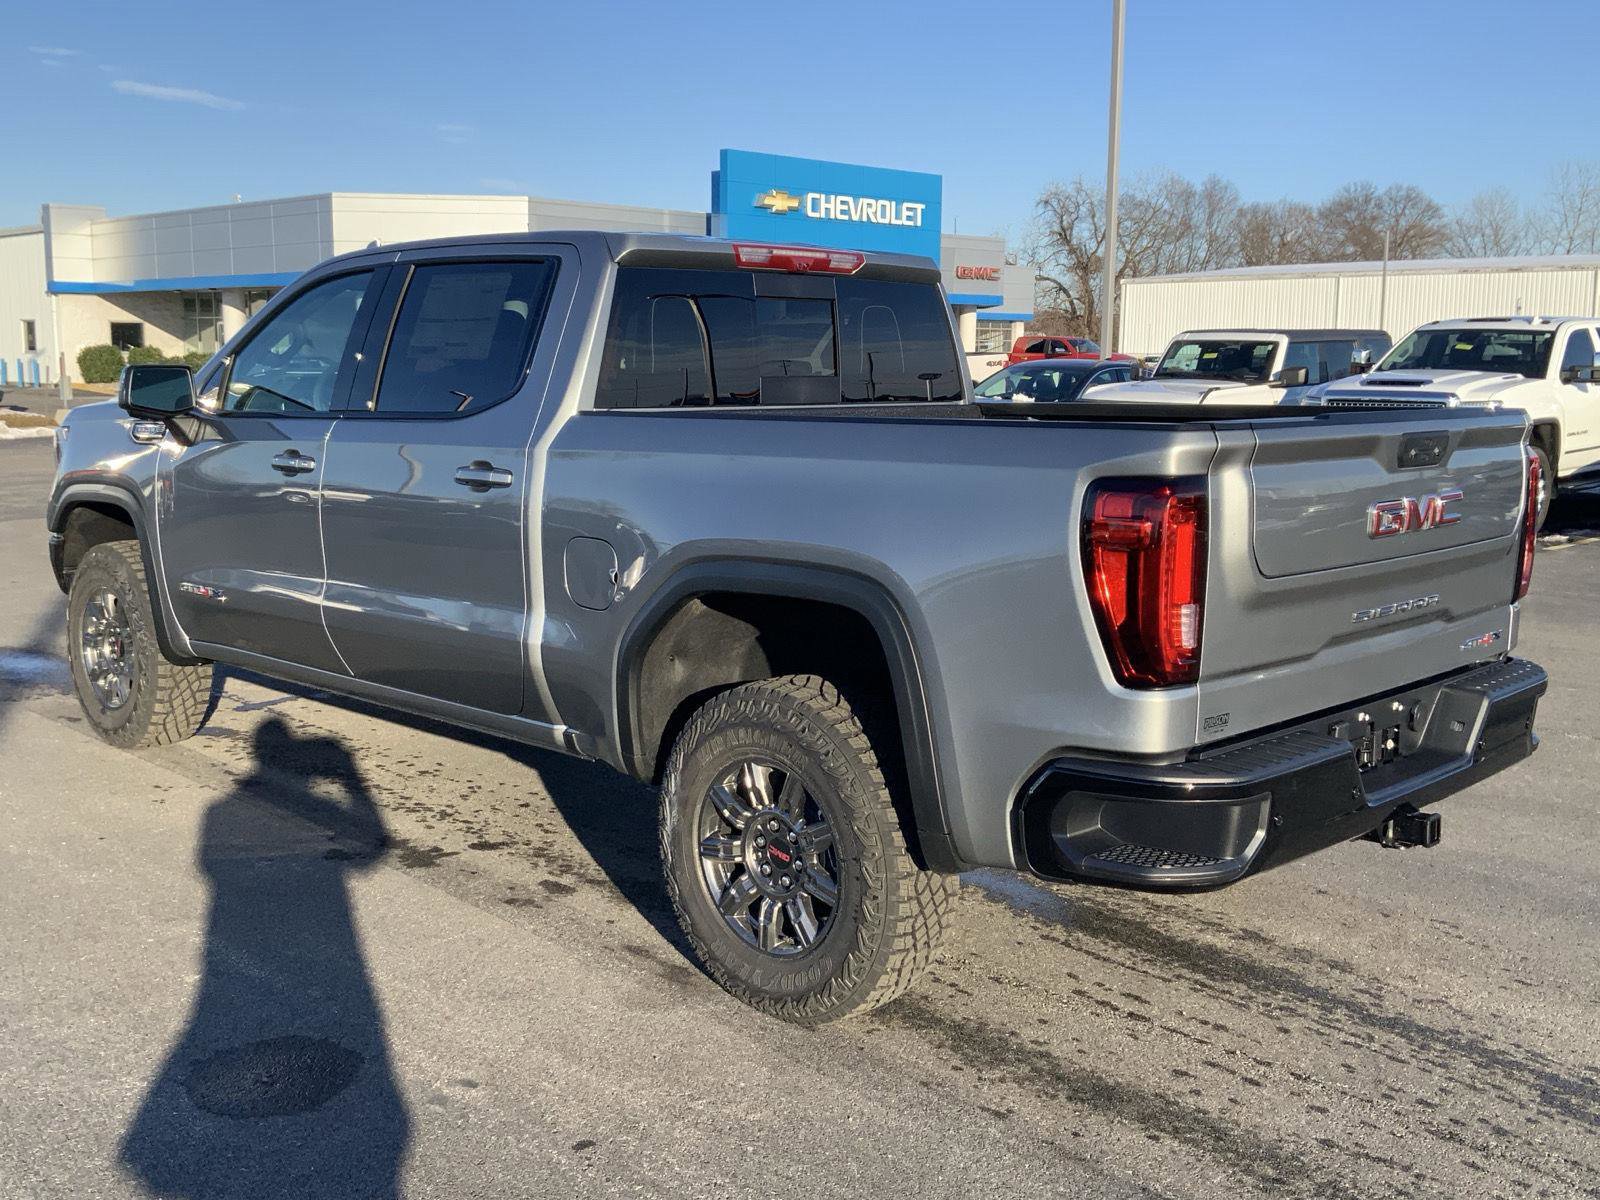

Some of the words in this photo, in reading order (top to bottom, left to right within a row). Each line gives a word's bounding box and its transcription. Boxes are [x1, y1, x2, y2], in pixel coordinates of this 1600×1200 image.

[806, 192, 926, 227] CHEVROLET
[956, 266, 1001, 281] GMC
[1367, 488, 1464, 540] GMC
[1352, 594, 1440, 623] SIERRA
[768, 844, 791, 863] GMC
